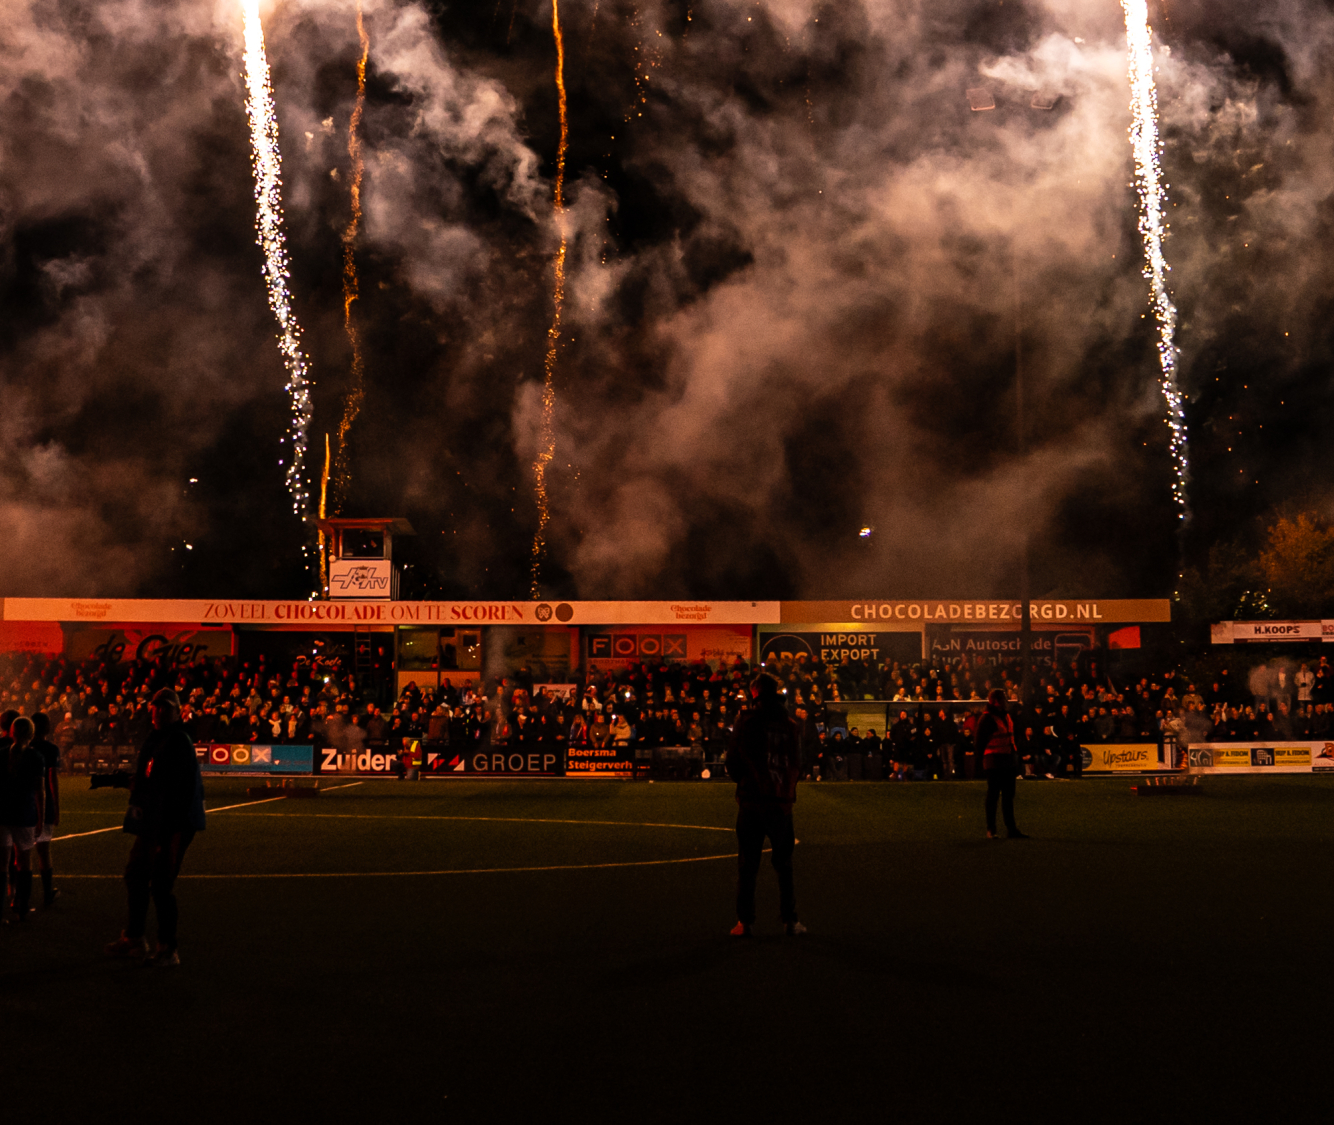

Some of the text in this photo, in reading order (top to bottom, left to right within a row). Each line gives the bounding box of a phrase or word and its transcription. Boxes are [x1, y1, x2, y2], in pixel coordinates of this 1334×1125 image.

[204, 604, 524, 621] ZOVEEL CHOCOLADE OM TE SCOREN
[670, 604, 712, 614] Chocolade
[675, 612, 707, 621] bezorgd
[851, 603, 1103, 620] CHOCOLADEBEZORGD.NL
[593, 638, 685, 655] FOOX
[820, 634, 877, 646] IMPORT
[965, 637, 1053, 652] Autoschde
[821, 649, 880, 660] EXPORT
[320, 748, 397, 771] Zuider
[568, 748, 617, 757] Boersma
[1103, 750, 1148, 768] Upstairs
[472, 753, 556, 772] GROEP
[568, 760, 633, 772] Steigerverh
